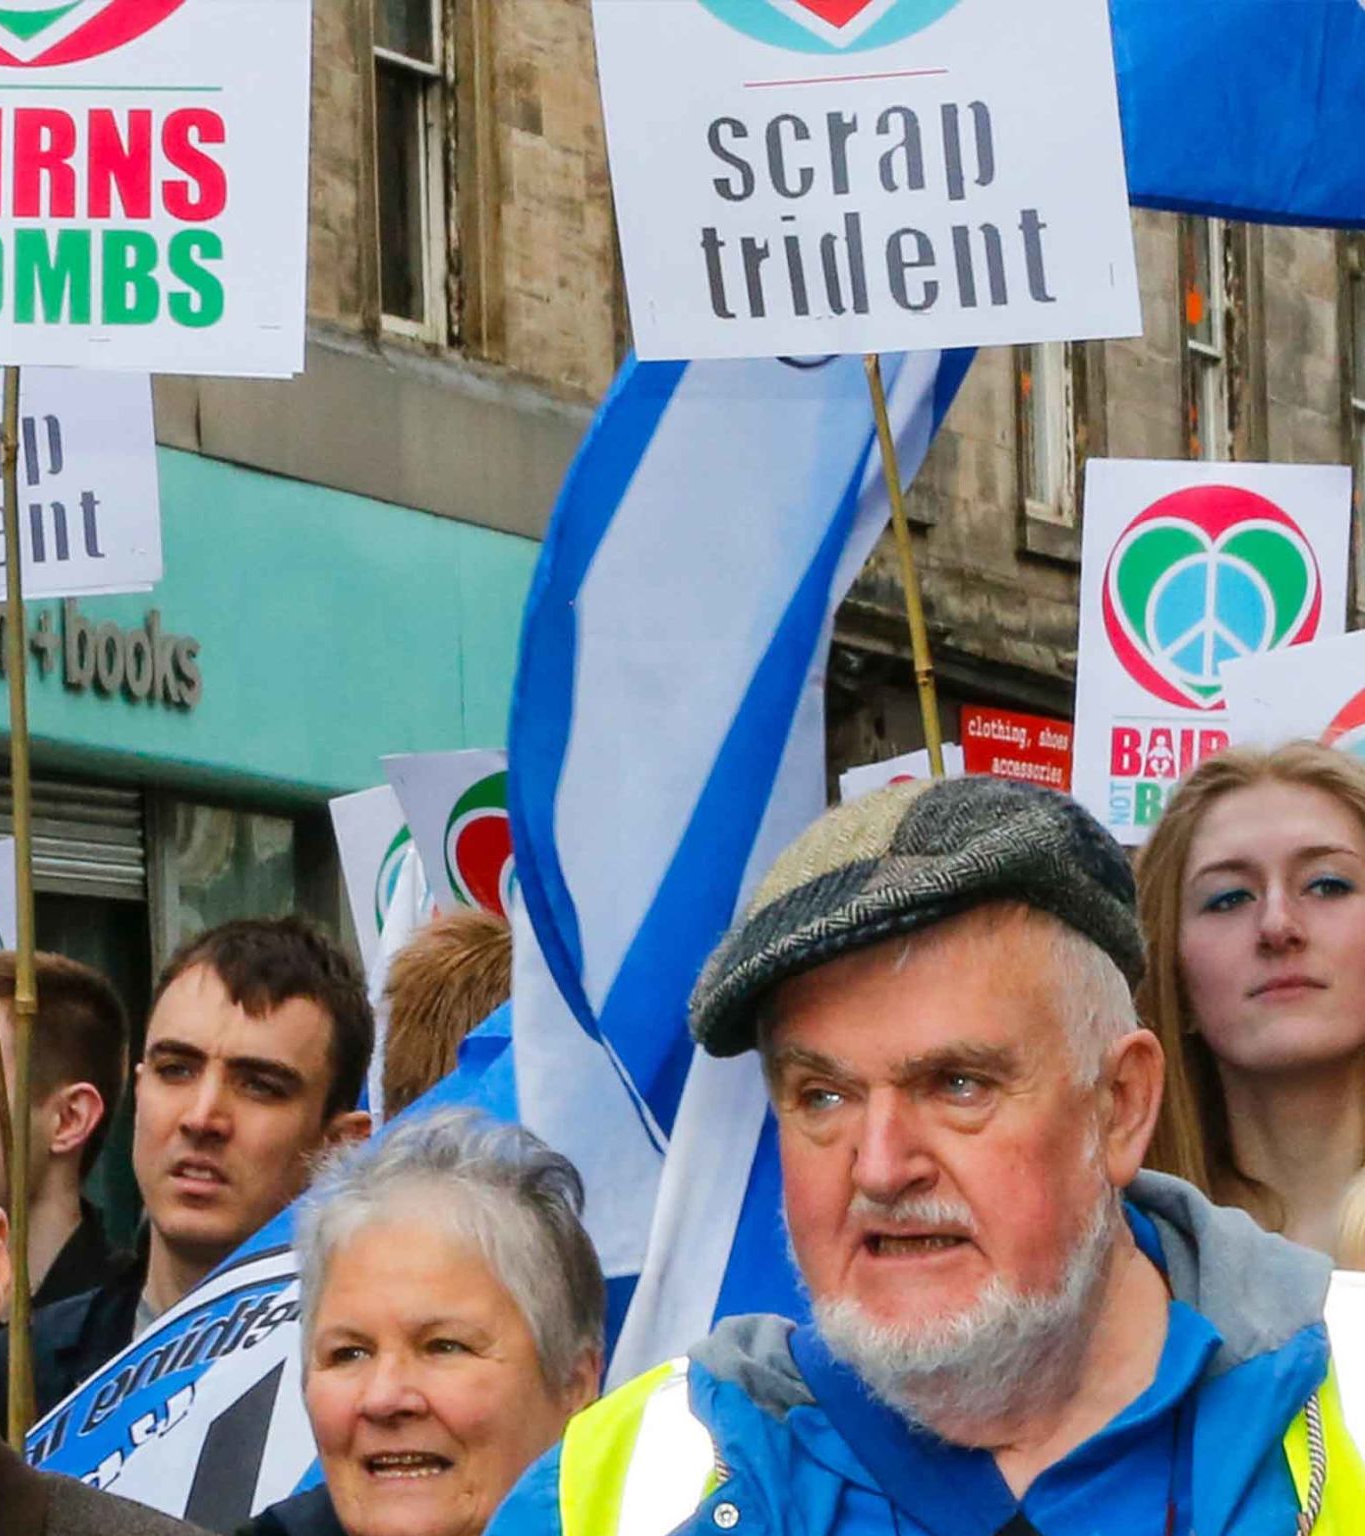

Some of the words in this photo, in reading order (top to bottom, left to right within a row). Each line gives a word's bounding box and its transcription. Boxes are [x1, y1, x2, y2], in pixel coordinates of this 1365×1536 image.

[707, 100, 996, 202] scrap
[700, 208, 1057, 320] trident
[65, 597, 202, 709] books
[967, 716, 1033, 749] clothing,
[1039, 726, 1070, 751] shoes
[992, 756, 1064, 784] accessories
